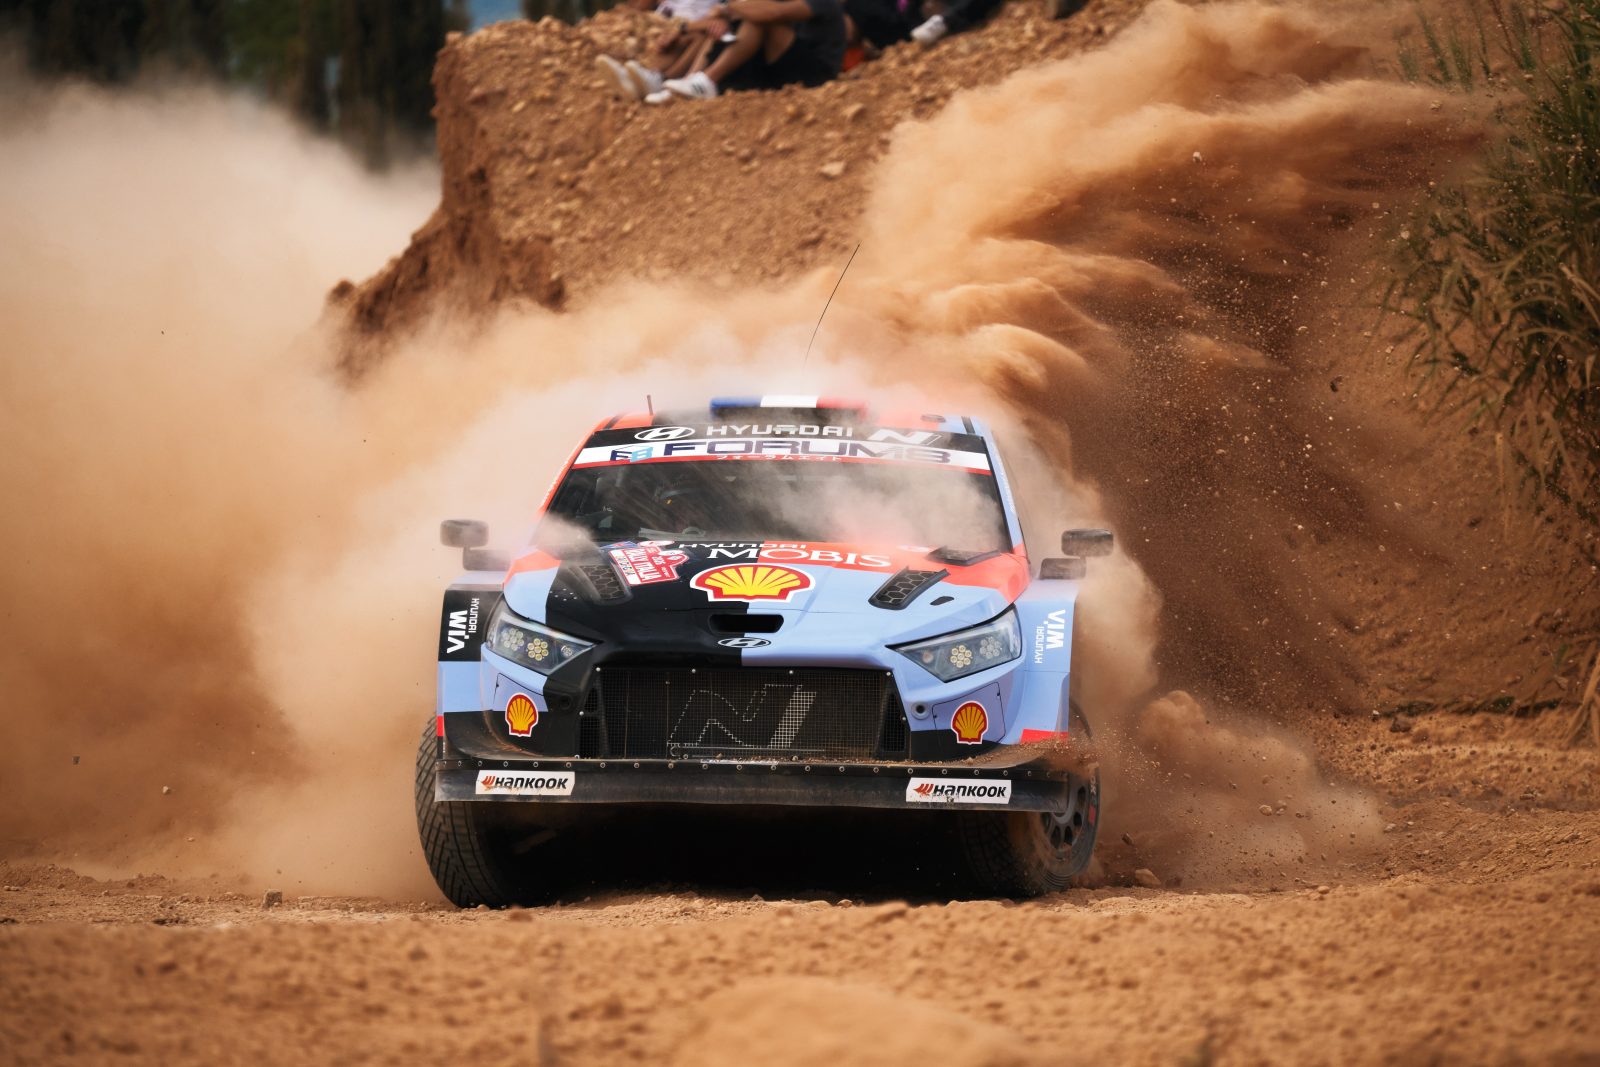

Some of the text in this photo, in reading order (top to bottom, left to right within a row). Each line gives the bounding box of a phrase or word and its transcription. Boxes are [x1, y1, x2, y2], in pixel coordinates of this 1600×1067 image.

[706, 424, 853, 437] HYUNDAI
[664, 440, 950, 463] FORUM8
[707, 549, 892, 567] MOBIS
[446, 610, 470, 654] WIA
[468, 598, 480, 633] HYUNDAI
[1043, 609, 1066, 649] WIA
[1034, 626, 1045, 664] HYUNDAI
